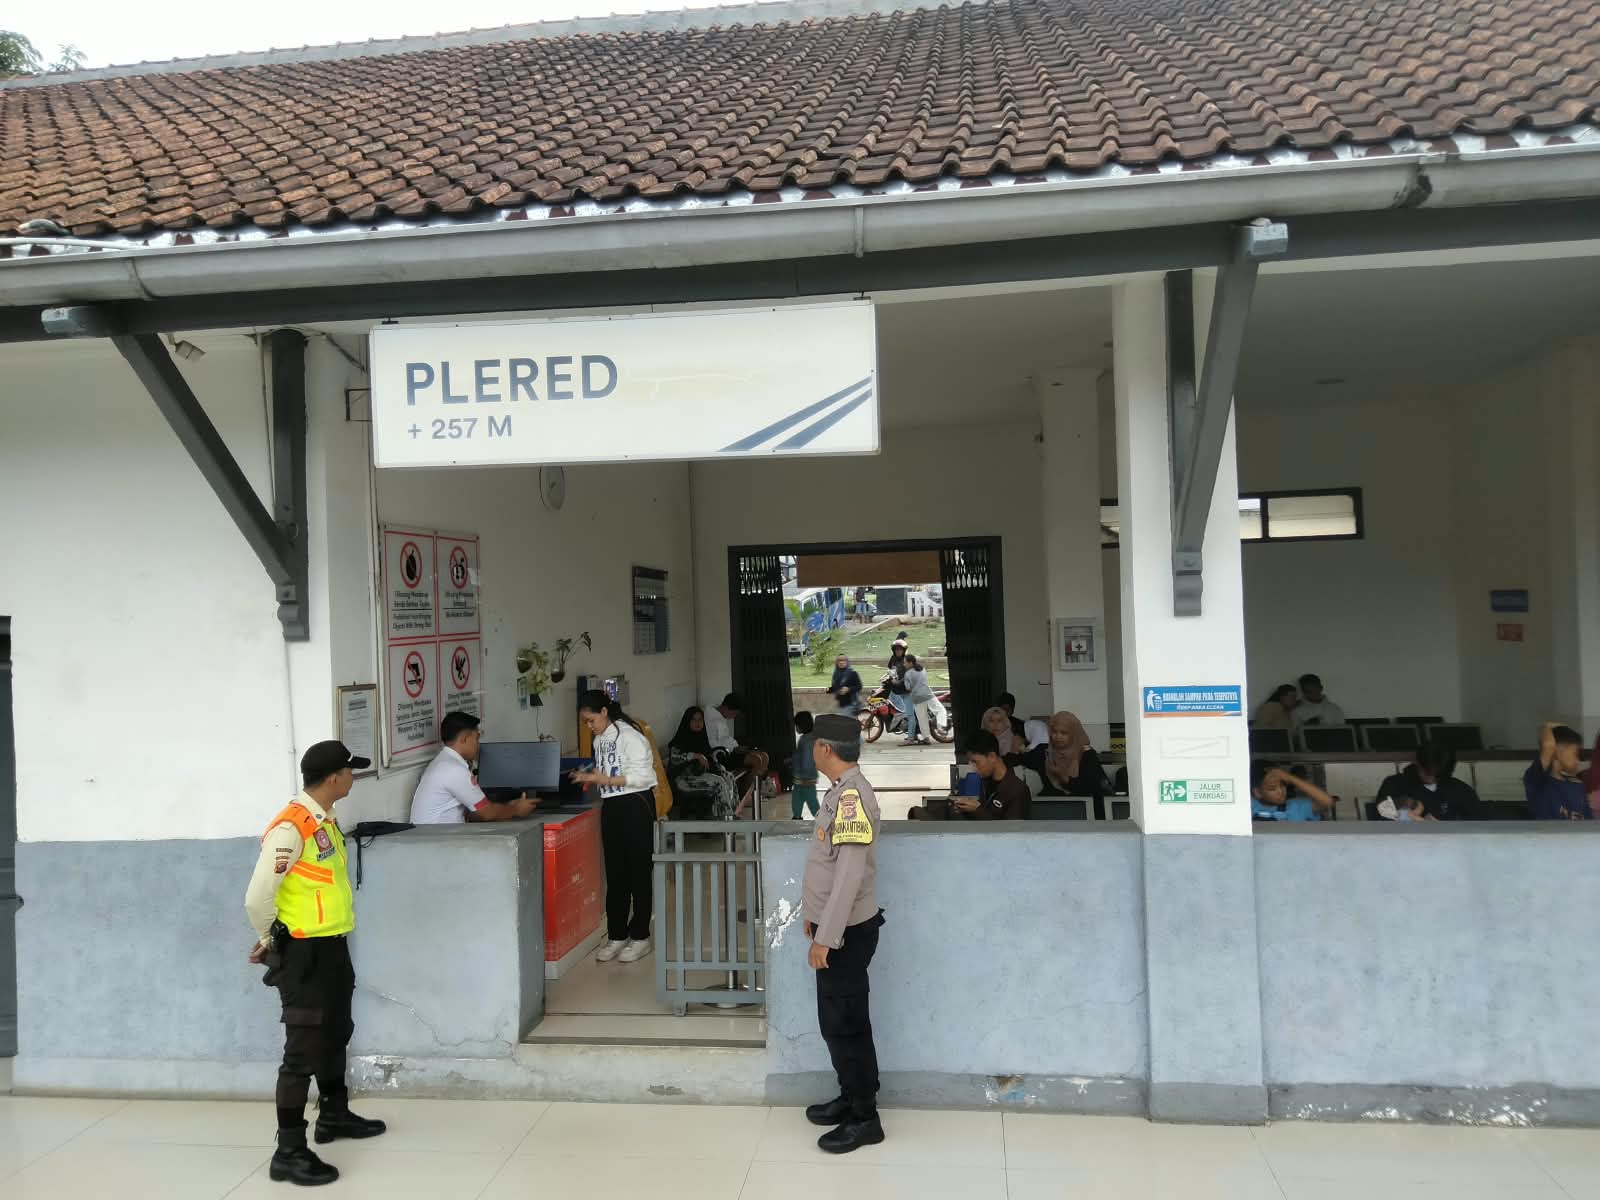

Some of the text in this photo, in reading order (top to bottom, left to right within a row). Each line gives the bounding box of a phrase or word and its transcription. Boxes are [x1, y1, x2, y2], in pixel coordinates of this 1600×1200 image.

[406, 355, 618, 406] PLERED
[431, 417, 478, 439] 257
[487, 415, 512, 438] M
[1199, 783, 1221, 791] JALUR
[1193, 792, 1227, 800] EVAKUASI
